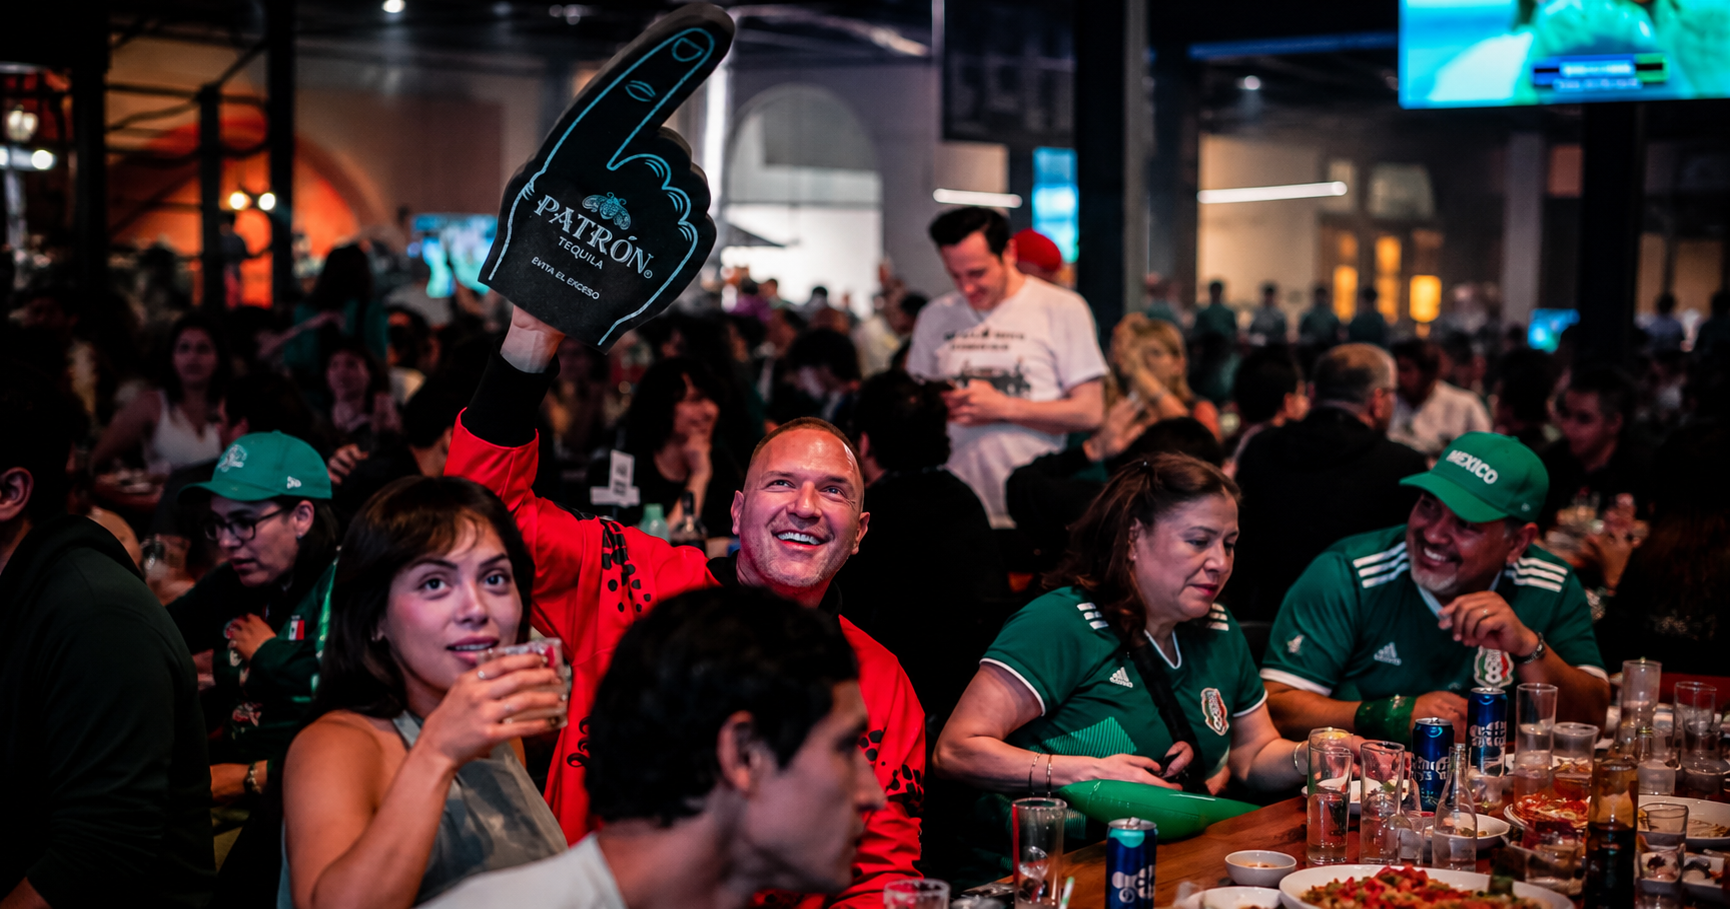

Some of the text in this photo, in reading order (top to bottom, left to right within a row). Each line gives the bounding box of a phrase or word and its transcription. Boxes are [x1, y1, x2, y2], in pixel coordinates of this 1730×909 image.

[533, 194, 655, 275] PATRÓN
[558, 235, 603, 270] TEQUILA
[555, 271, 565, 282] EL
[566, 277, 600, 300] EXCESO
[1446, 449, 1499, 485] MEXICO
